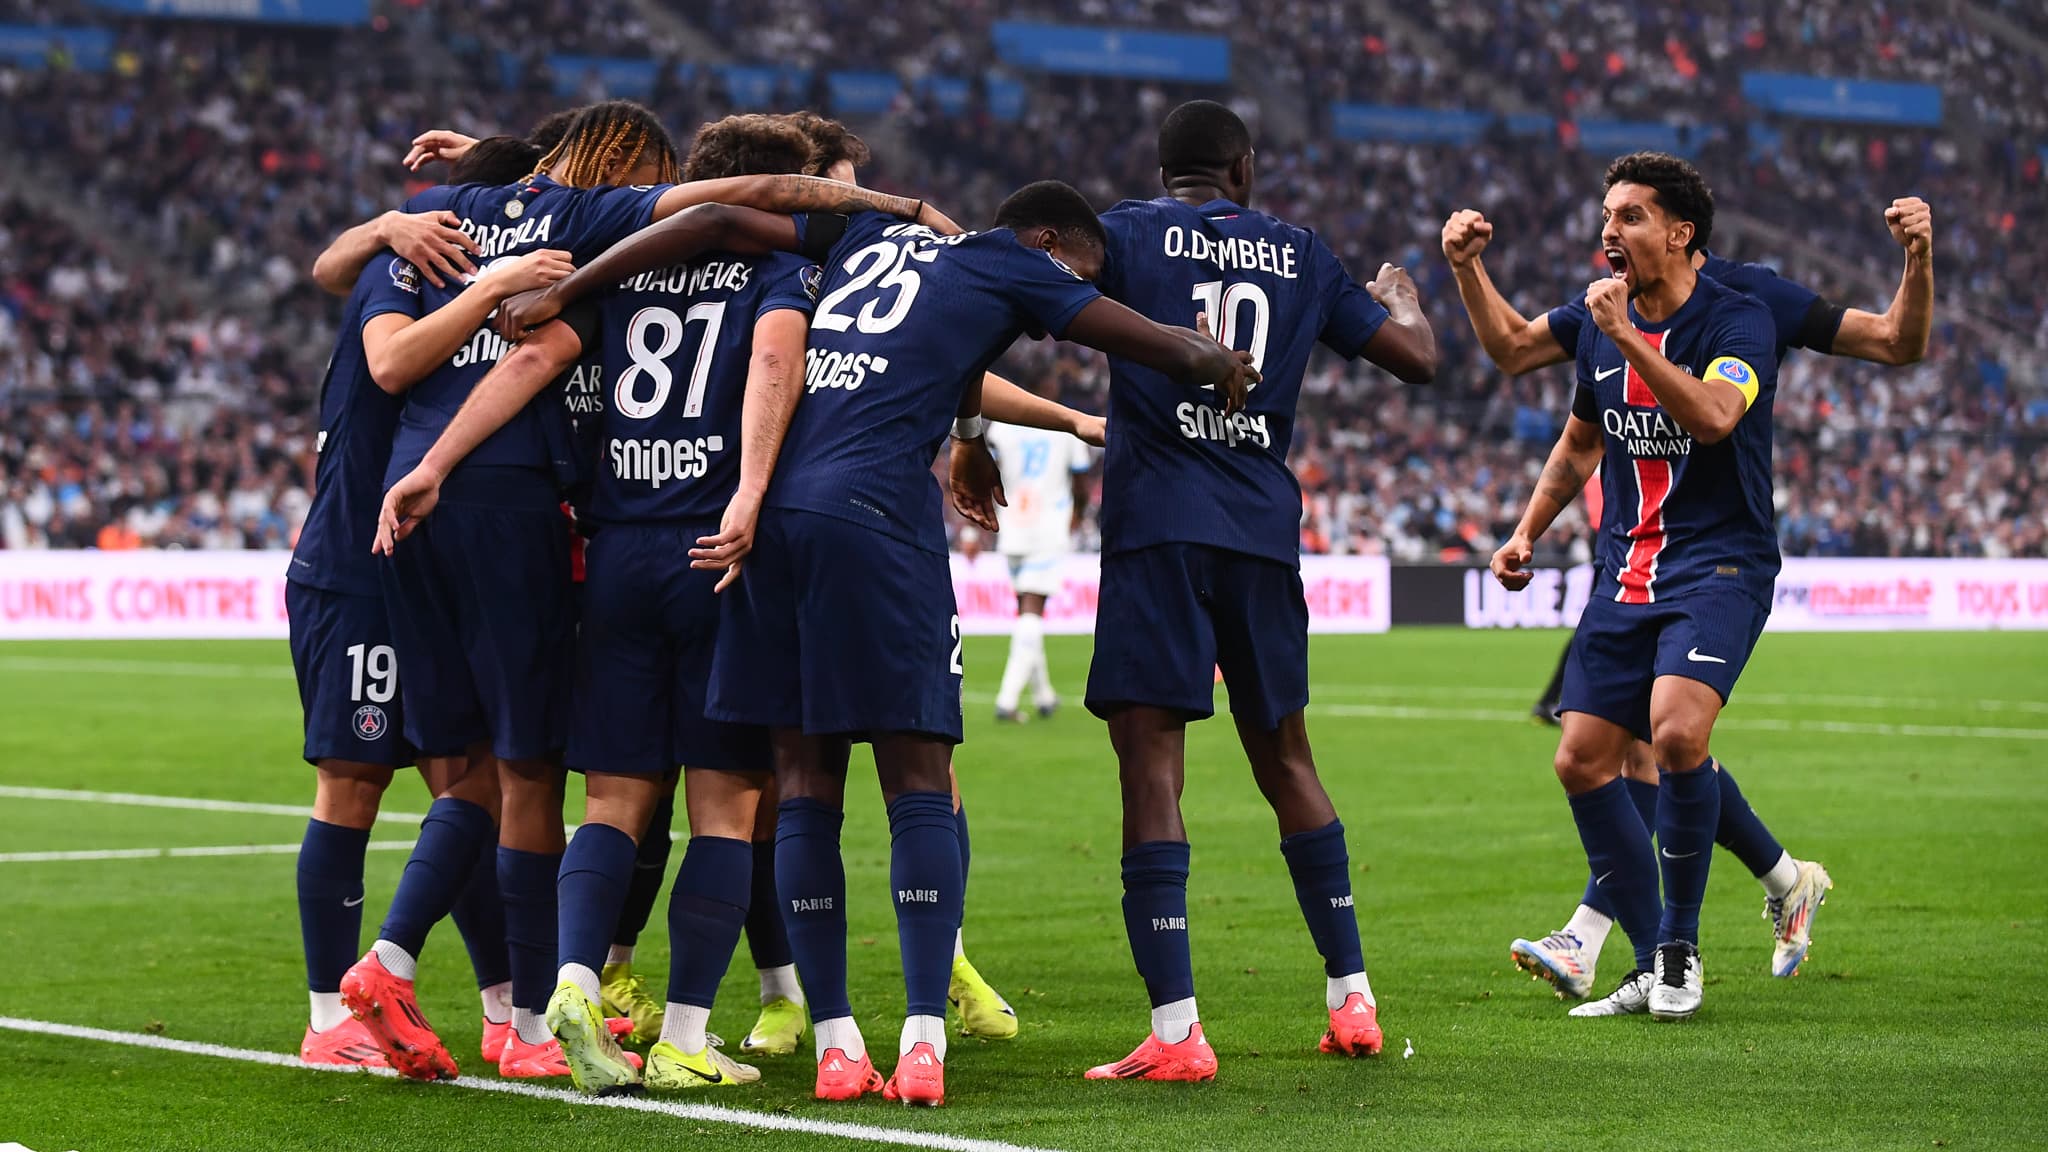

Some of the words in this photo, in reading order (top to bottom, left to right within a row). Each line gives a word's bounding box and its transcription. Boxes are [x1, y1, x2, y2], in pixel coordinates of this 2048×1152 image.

[1164, 225, 1298, 279] O.DEMBÉLÉ
[811, 240, 939, 334] 25
[614, 300, 726, 420] 87
[1191, 280, 1270, 393] 10
[610, 435, 708, 489] snipes
[1627, 437, 1692, 456] AIRWAYS
[2, 579, 93, 621] UNIS
[107, 577, 259, 621] CONTRE
[1957, 580, 2020, 621] TOUS
[346, 643, 398, 703] 19
[791, 897, 833, 913] PARIS
[898, 889, 938, 903] PARIS
[1151, 916, 1186, 931] PARIS
